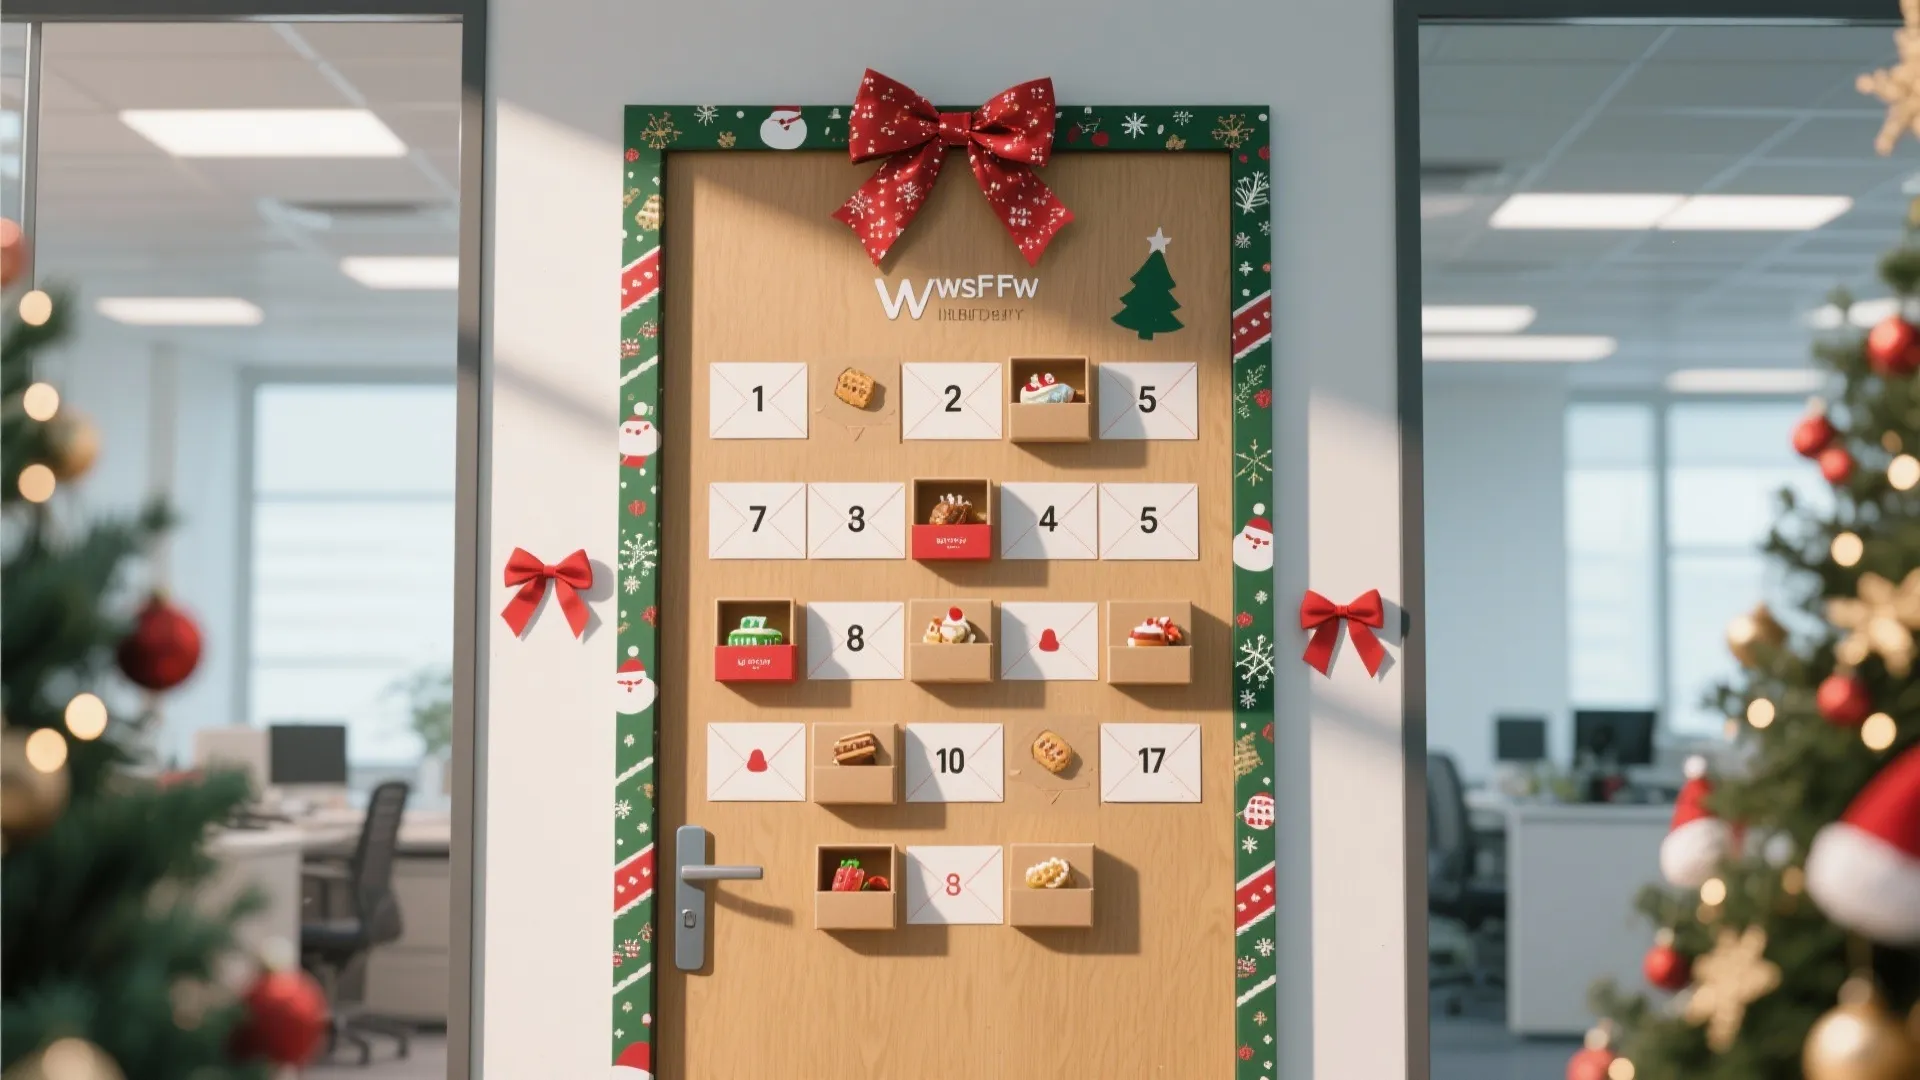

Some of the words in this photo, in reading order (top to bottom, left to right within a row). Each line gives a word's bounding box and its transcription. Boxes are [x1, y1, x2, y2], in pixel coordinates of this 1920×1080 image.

[752, 385, 763, 412] 1
[944, 384, 962, 412] 2
[1138, 385, 1157, 413] 5
[749, 505, 767, 533] 7
[848, 505, 865, 533] 3
[1039, 505, 1058, 532] 4
[1140, 506, 1158, 534] 5
[846, 624, 865, 652] 8
[936, 747, 965, 774] 10
[1138, 747, 1166, 774] 17
[945, 873, 962, 897] 8
